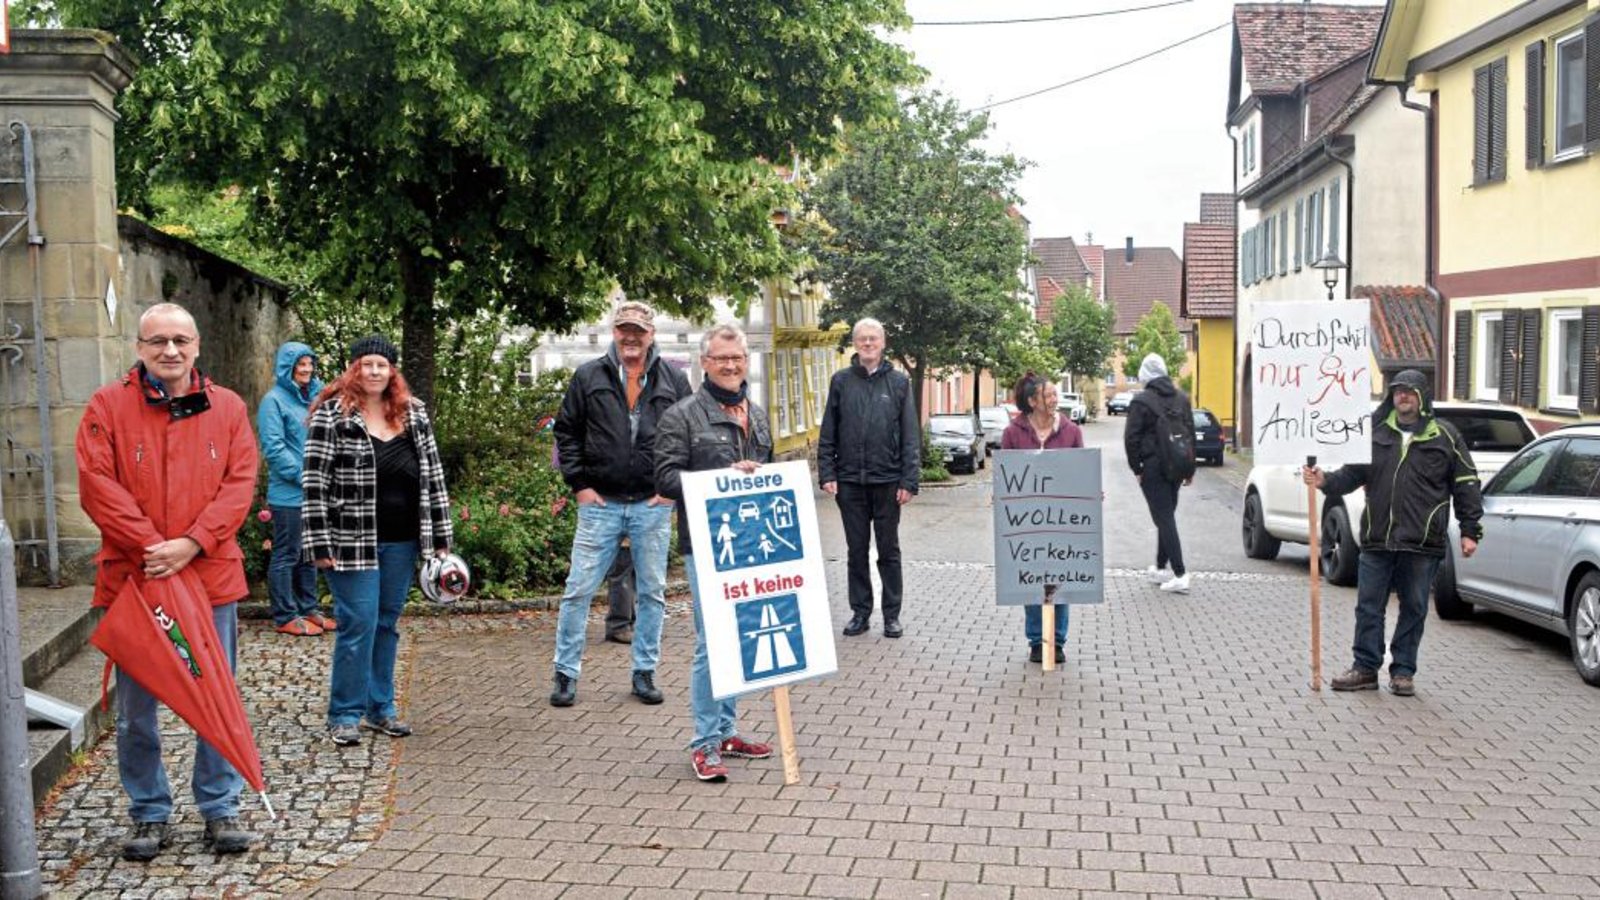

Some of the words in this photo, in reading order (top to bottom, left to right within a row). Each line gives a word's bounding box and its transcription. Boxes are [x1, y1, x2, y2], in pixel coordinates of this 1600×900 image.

[1260, 361, 1307, 387] nur
[1258, 403, 1371, 445] Anlieger
[715, 473, 783, 493] Unsere
[1000, 464, 1053, 493] Wir
[1008, 540, 1098, 562] Verkehrs-
[723, 581, 749, 600] ist
[754, 574, 804, 595] keine
